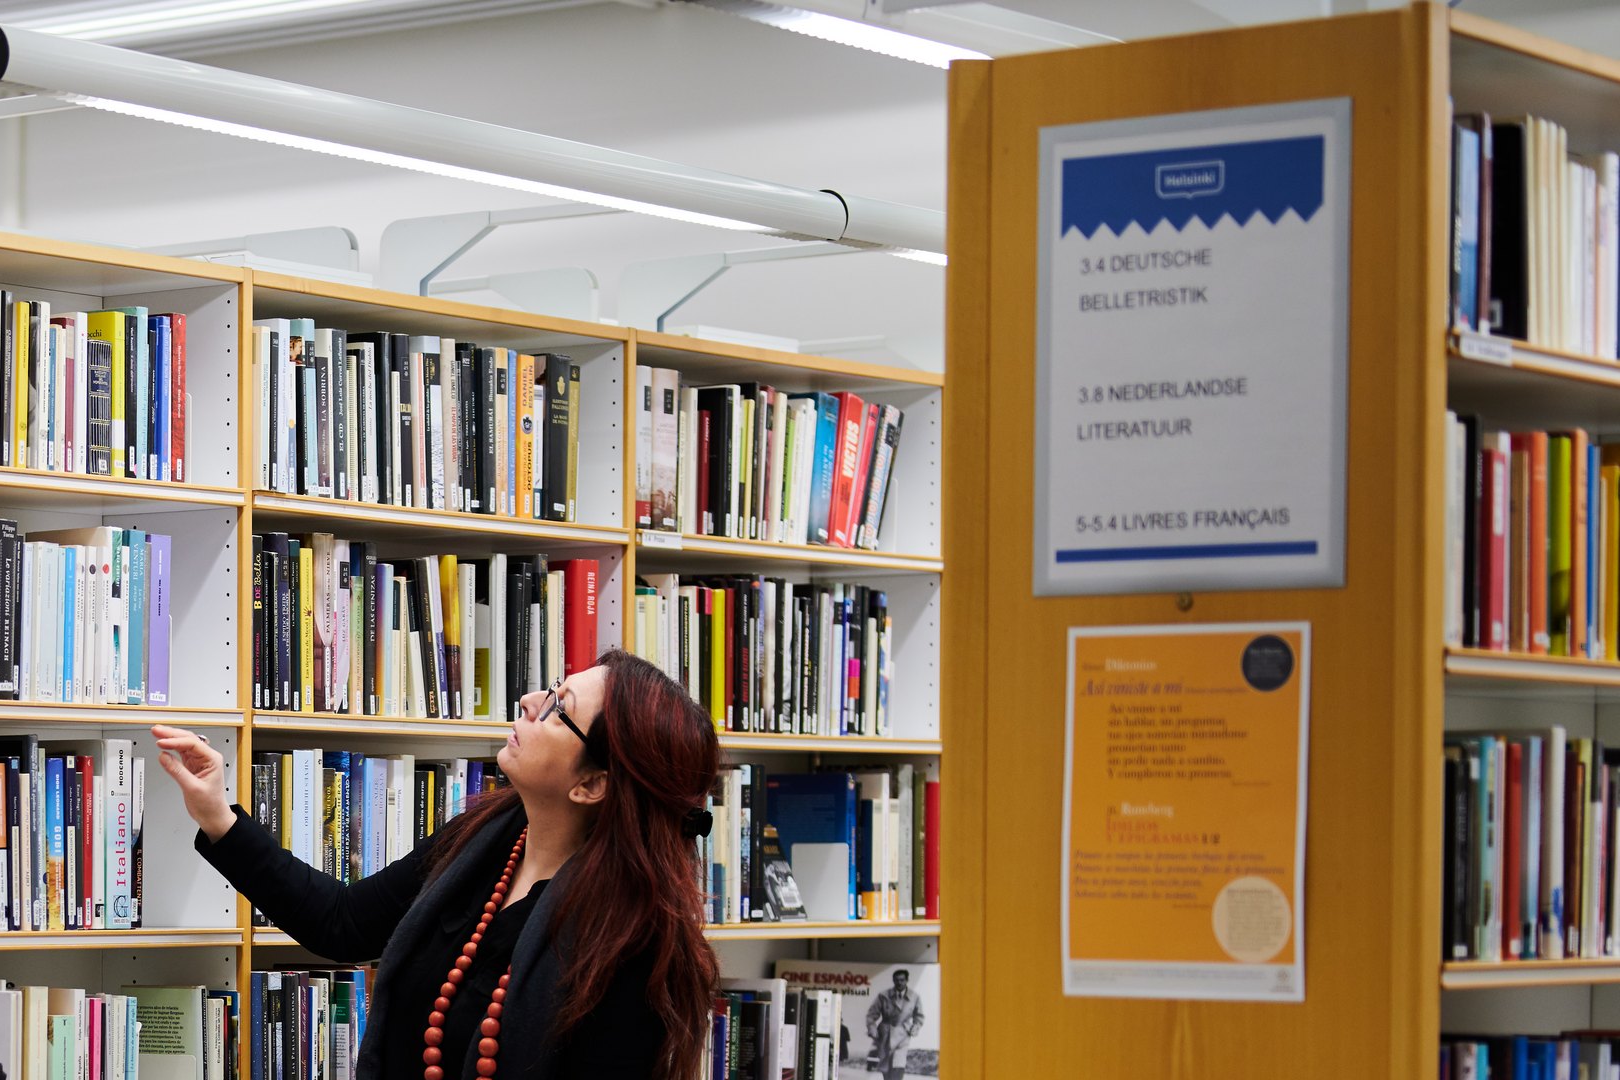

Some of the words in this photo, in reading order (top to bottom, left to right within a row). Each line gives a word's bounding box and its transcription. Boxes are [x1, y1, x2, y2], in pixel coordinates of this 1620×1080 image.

[1164, 170, 1216, 188] Helsinki
[1081, 257, 1105, 274] 3.4
[1111, 248, 1212, 272] DEUTSCHE
[1080, 287, 1209, 312] BELLETRISTIK
[1079, 386, 1104, 403] 3.8
[1108, 377, 1248, 402] NEDERLANDSE
[1077, 418, 1192, 441] LITERATUUR
[842, 419, 860, 478] VICTUS
[1076, 515, 1118, 533] 5-5.4
[1122, 510, 1189, 531] LIVRES
[1193, 508, 1291, 530] FRANÇAIS
[254, 585, 261, 599] DE
[587, 571, 595, 594] REINA
[254, 600, 262, 609] B
[587, 595, 595, 615] ROJA
[54, 826, 62, 853] GOBI
[116, 802, 126, 887] Italiano
[780, 970, 810, 983] CINE
[814, 970, 871, 986] ESPAÑOL
[842, 987, 870, 996] visual
